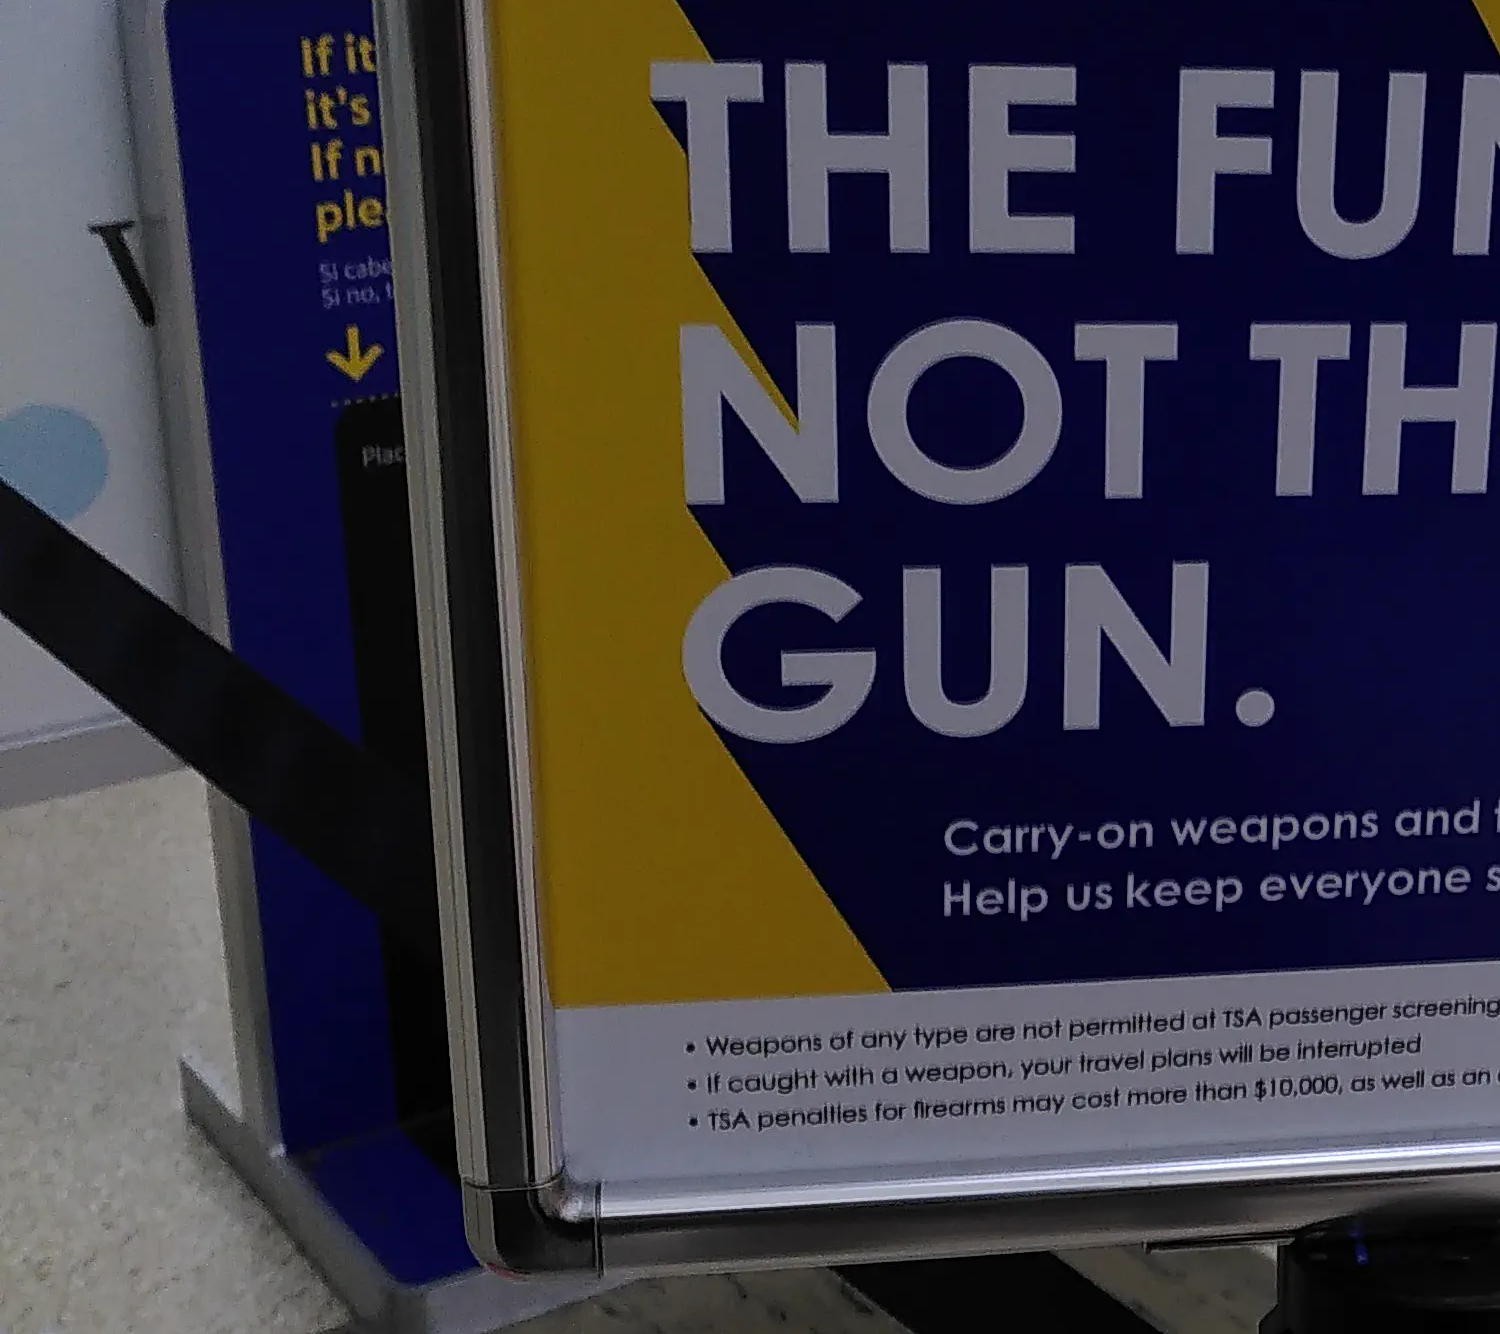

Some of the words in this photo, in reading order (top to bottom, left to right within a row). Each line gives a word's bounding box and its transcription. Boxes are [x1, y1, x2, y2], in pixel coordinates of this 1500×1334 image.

[300, 33, 335, 78] If
[305, 84, 372, 131] it's
[311, 138, 344, 182] If
[649, 60, 1077, 255] THE
[316, 188, 387, 244] ple
[679, 317, 1178, 506] NOT
[681, 560, 1275, 744] GUN.
[944, 818, 1154, 860] Carry-on
[1170, 809, 1379, 851] weapons
[1395, 797, 1481, 837] and
[943, 878, 1049, 922] Help
[1066, 880, 1113, 912] us
[1126, 871, 1243, 913] keep
[1259, 865, 1472, 906] everyone
[706, 1034, 823, 1059] Weapons
[829, 1028, 854, 1052] of
[861, 1029, 907, 1051] any
[913, 1024, 968, 1049] type
[975, 1025, 1016, 1043] are
[1023, 1018, 1063, 1040] not
[1069, 1010, 1185, 1042] permitted
[1192, 1007, 1216, 1030] at
[1222, 1006, 1262, 1028] TSA
[1269, 1004, 1387, 1030] passenger
[1392, 994, 1500, 1019] screening
[707, 1072, 721, 1095] If
[727, 1069, 818, 1095] caught
[824, 1065, 874, 1088] with
[881, 1067, 898, 1084] a
[905, 1059, 1013, 1084] weapon,
[1020, 1055, 1072, 1080] your
[1078, 1048, 1145, 1074] travel
[1151, 1047, 1213, 1072] plans
[1219, 1041, 1253, 1065] will
[1260, 1042, 1290, 1062] be
[1297, 1033, 1422, 1060] interrupted
[707, 1110, 750, 1132] TSA
[758, 1102, 868, 1133] penalties
[875, 1101, 906, 1122] for
[914, 1097, 1006, 1120] firearms
[1012, 1093, 1065, 1114] may
[1071, 1086, 1120, 1110] cost
[1127, 1085, 1188, 1107] more
[1195, 1079, 1247, 1102] than
[1254, 1072, 1344, 1102] $10,000,
[1350, 1076, 1375, 1094] as
[1382, 1070, 1425, 1090] well
[1431, 1071, 1456, 1088] as
[1462, 1068, 1490, 1086] an
